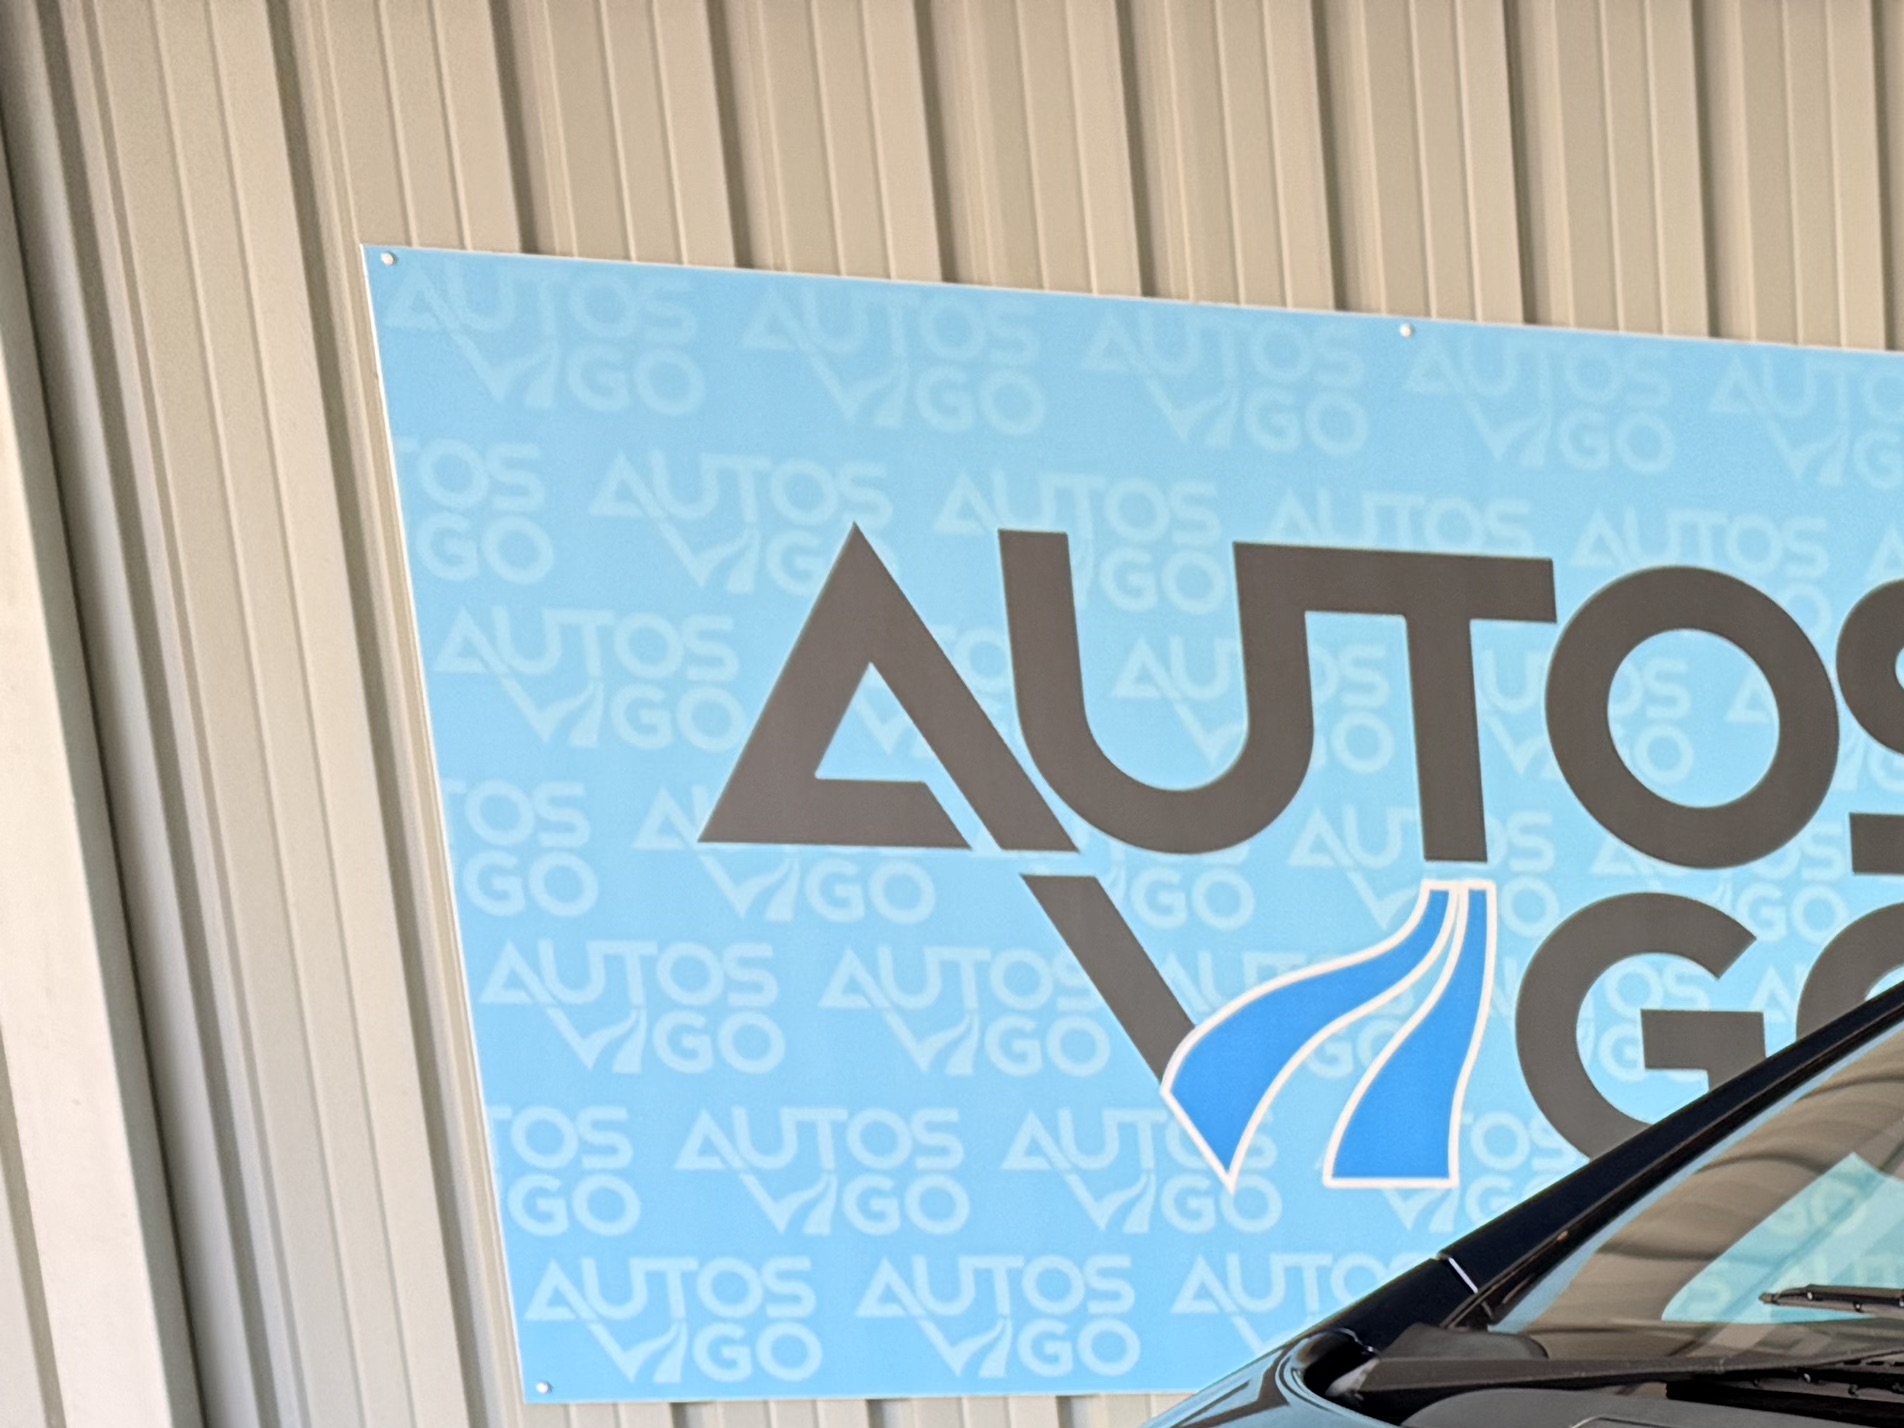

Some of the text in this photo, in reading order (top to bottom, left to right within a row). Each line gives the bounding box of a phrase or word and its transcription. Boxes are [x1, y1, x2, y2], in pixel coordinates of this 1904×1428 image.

[384, 260, 699, 345] AUTOS
[742, 286, 1040, 368] AUTOS
[1081, 310, 1364, 389] AUTOS
[1402, 333, 1672, 410] AUTOS
[591, 452, 894, 531] AUTOS
[433, 607, 740, 683] AUTOS
[480, 939, 779, 1008] AUTOS
[676, 1107, 964, 1172] AUTOS
[524, 1257, 817, 1322] AUTOS
[857, 1256, 1136, 1319] AUTOS
